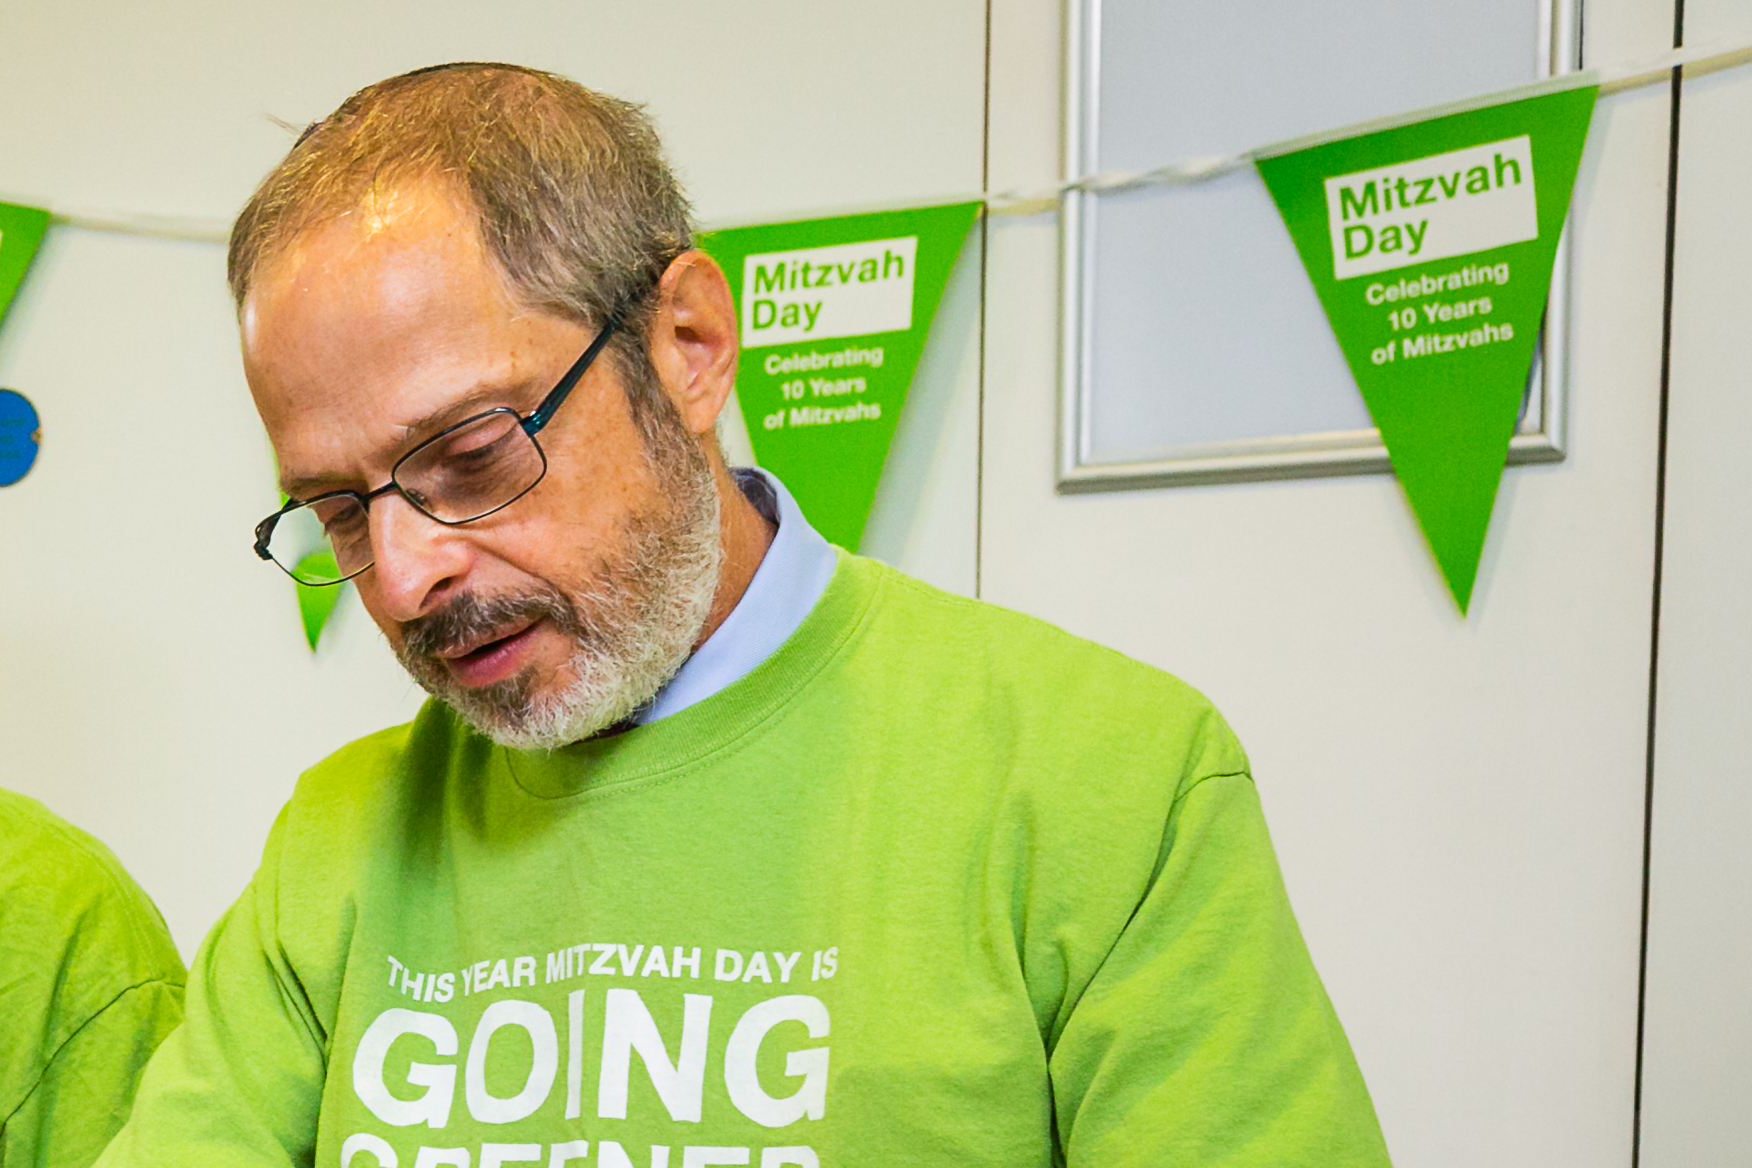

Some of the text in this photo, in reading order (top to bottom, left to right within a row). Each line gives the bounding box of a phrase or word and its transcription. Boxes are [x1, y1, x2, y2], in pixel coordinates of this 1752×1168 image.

[1339, 153, 1521, 222] Mitzvah
[1343, 219, 1429, 260] Day
[754, 250, 904, 294] Mitzvah
[1366, 262, 1510, 305] Celebrating
[752, 299, 822, 332] Day
[1388, 297, 1493, 331] 10 Years
[765, 346, 884, 375] Celebrating
[1371, 323, 1514, 366] of Mitzvahs
[782, 377, 866, 399] 10 Years
[764, 402, 881, 430] of Mitzvahs
[388, 943, 839, 1003] THIS YEAR MITZVAH DAY IS
[352, 988, 831, 1129] GOING
